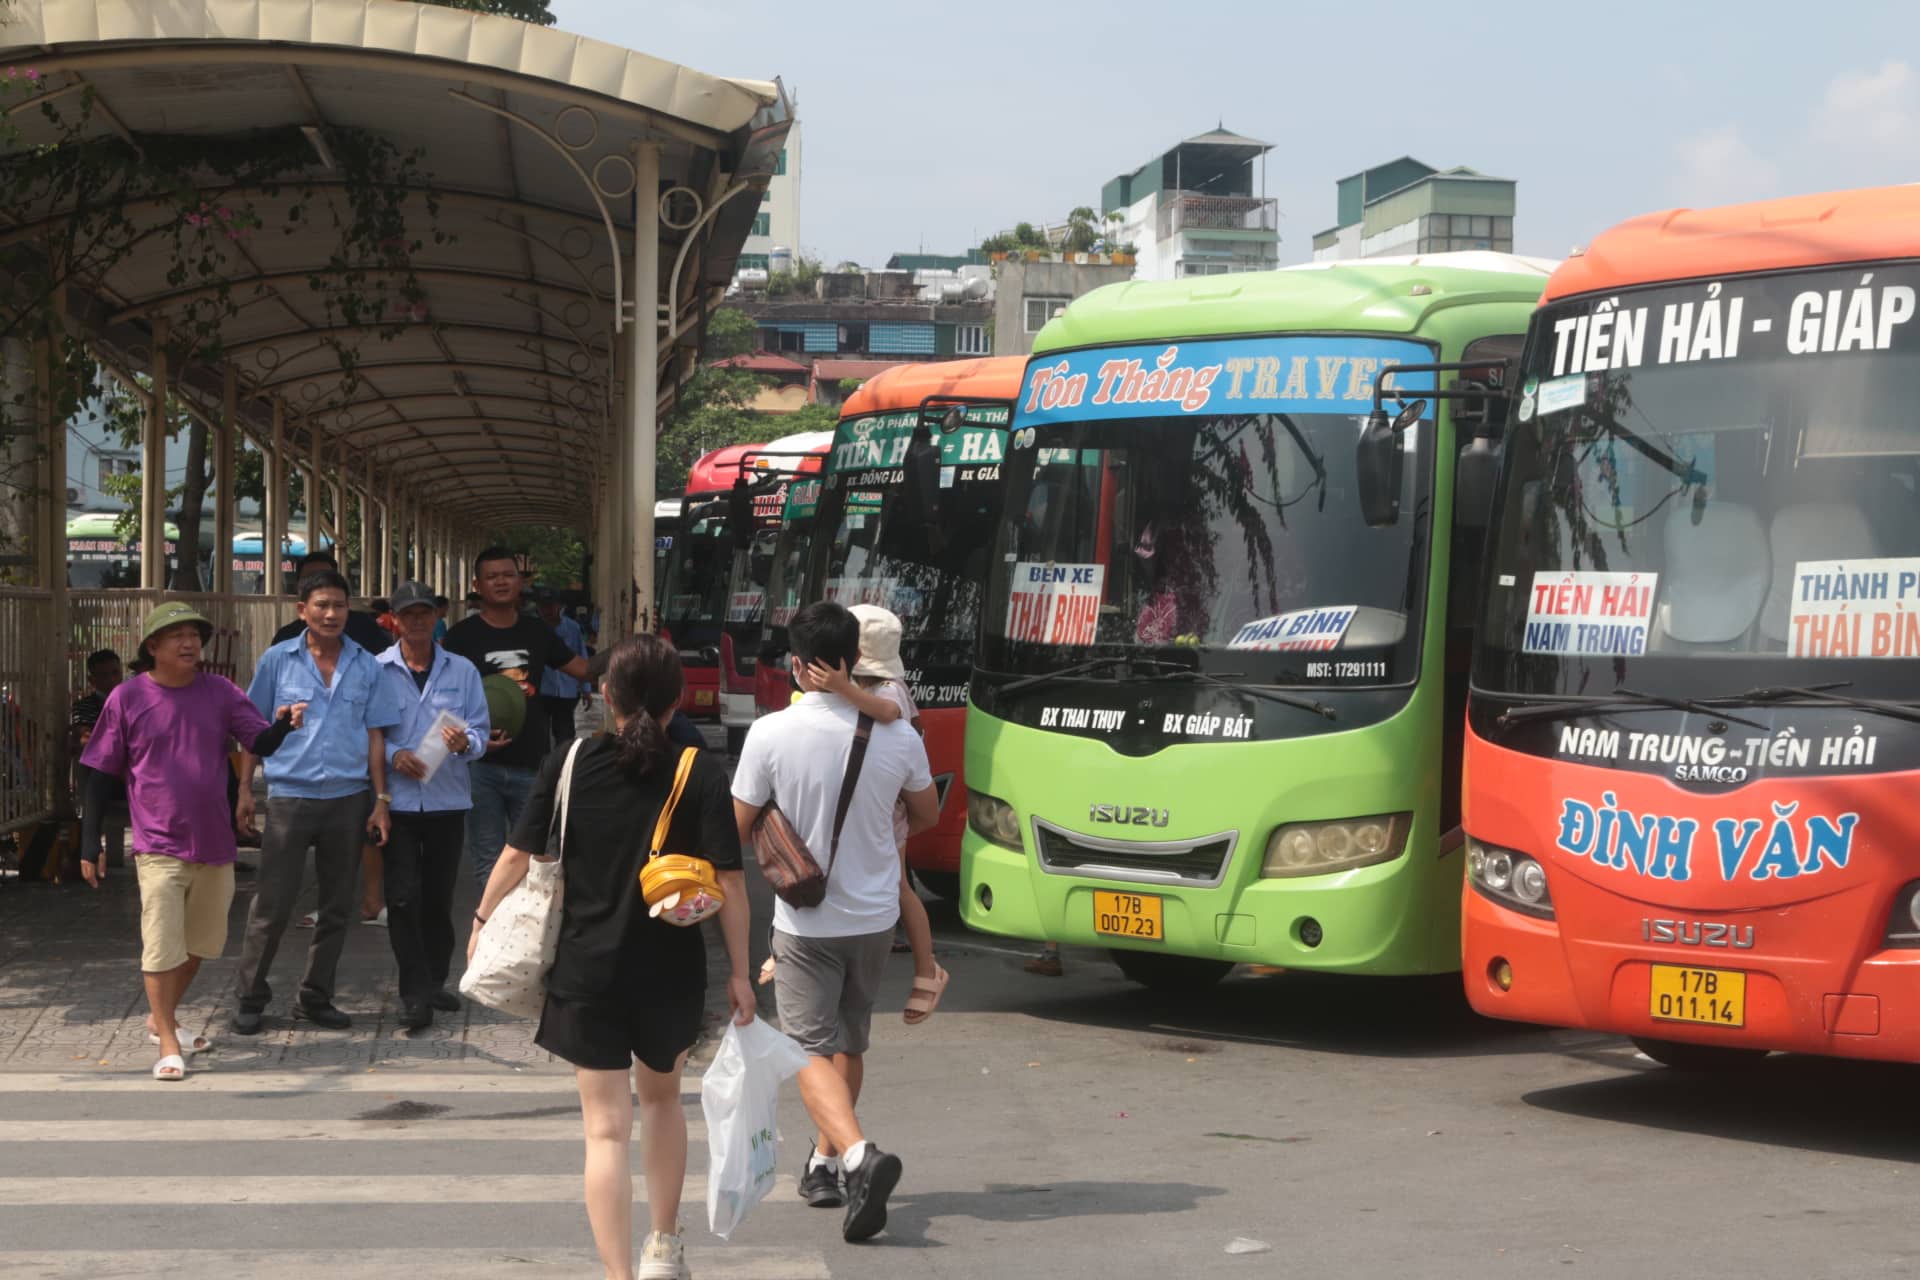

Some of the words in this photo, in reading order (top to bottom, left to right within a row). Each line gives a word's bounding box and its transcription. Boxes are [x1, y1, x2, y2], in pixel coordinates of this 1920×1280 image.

[1553, 296, 1648, 377] TIỀN
[1658, 282, 1744, 364] HẢI
[1753, 318, 1772, 333] -
[1786, 273, 1916, 355] GIÁP
[1024, 360, 1088, 413] Tôn
[1092, 346, 1222, 412] Thắng
[1226, 356, 1403, 402] TRAVEL
[835, 431, 886, 470] TIỀN
[960, 470, 975, 481] BX
[1071, 567, 1094, 584] XE
[1800, 565, 1888, 601] THÀNH
[1897, 571, 1920, 599] P
[1534, 572, 1593, 615] TIỀN
[1600, 574, 1650, 617] HẢI
[1009, 584, 1052, 643] THÁI
[1050, 585, 1098, 645] BÌNH
[1235, 615, 1288, 645] THÁI
[1287, 610, 1351, 637] BÌNH
[1793, 603, 1862, 657] THÁI
[1525, 622, 1571, 651] NAM
[1577, 624, 1645, 655] TRUNG
[1306, 662, 1332, 678] MST:
[1335, 662, 1386, 678] 17291111
[1040, 707, 1060, 727] BX
[1091, 710, 1126, 733] THỤY
[1162, 713, 1184, 733] BX
[1185, 711, 1220, 737] GIÁP
[1223, 713, 1253, 738] BÁT
[1559, 726, 1620, 758] NAM
[1819, 725, 1877, 766] HẢI
[1675, 765, 1748, 783] SAMCO
[1089, 803, 1169, 828] ISUZU
[1556, 791, 1699, 881] ĐÌNH
[1713, 800, 1860, 881] VĂN
[1114, 895, 1142, 914] 17B
[1101, 913, 1154, 936] 007.23
[1642, 918, 1756, 949] ISUZU
[1680, 970, 1718, 994] 17B
[1660, 994, 1733, 1022] 011.14
